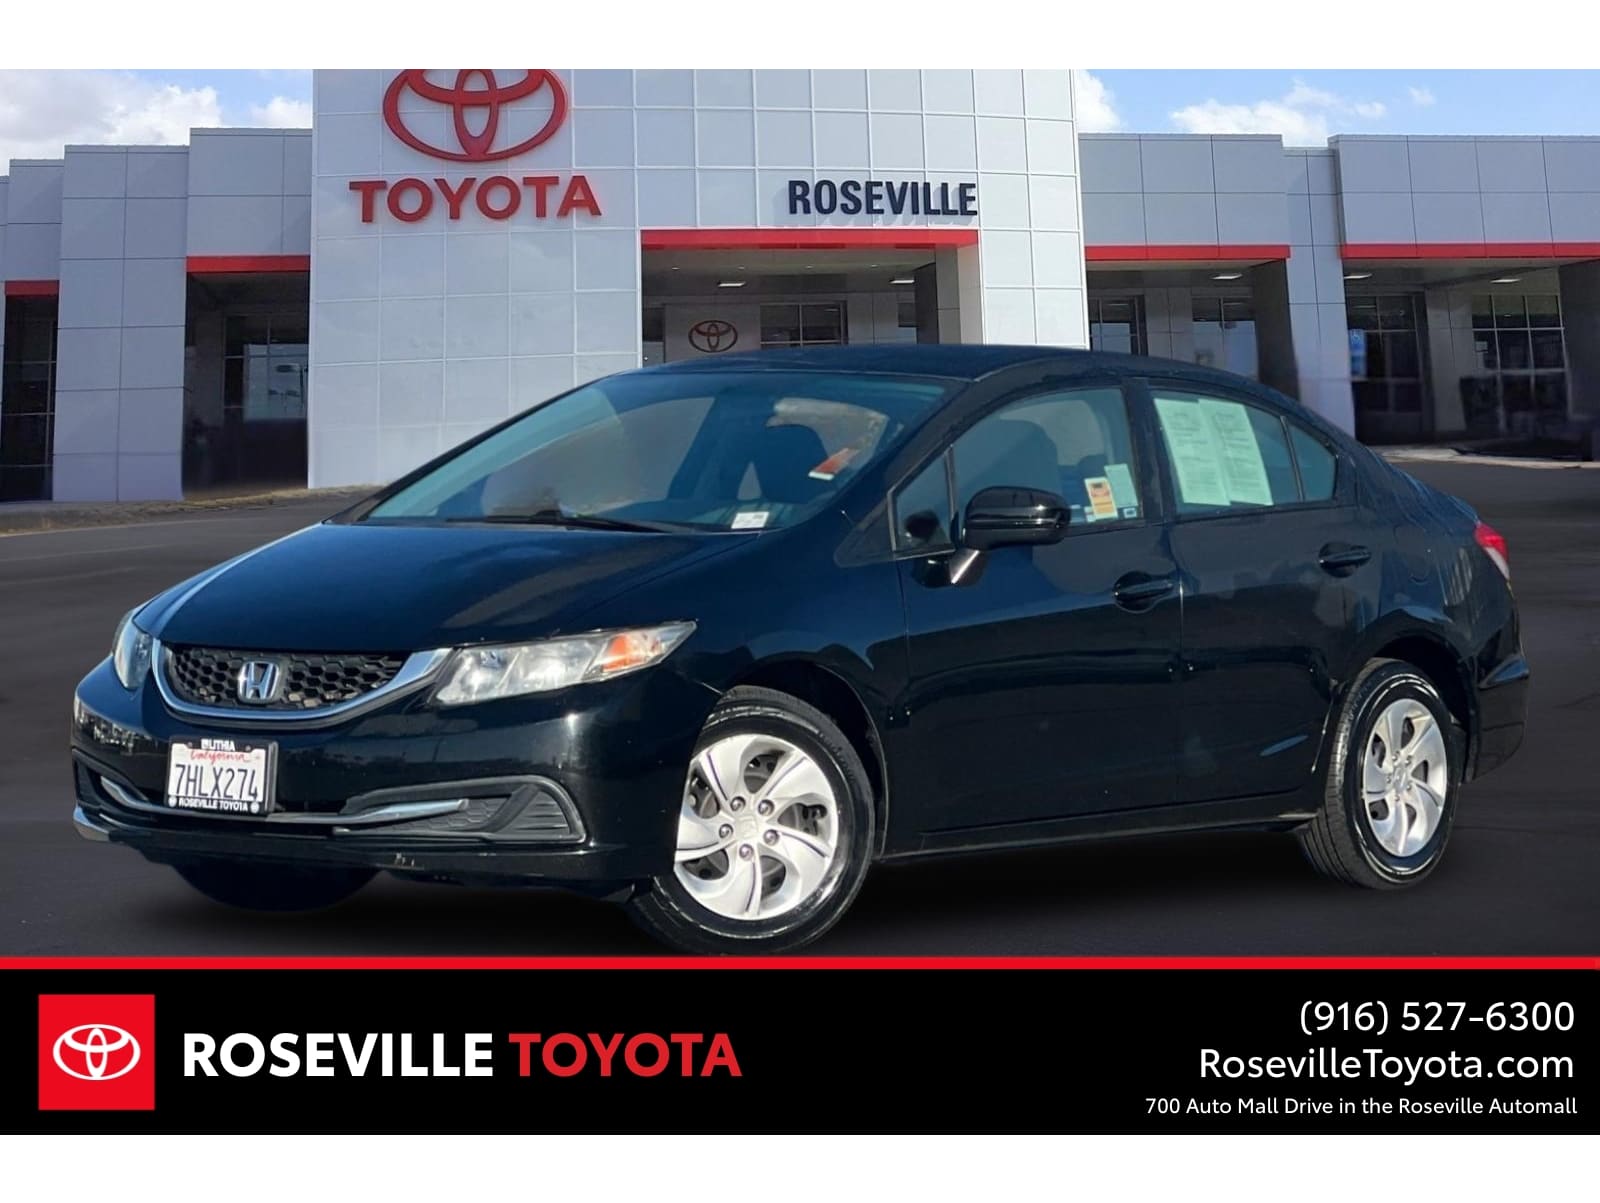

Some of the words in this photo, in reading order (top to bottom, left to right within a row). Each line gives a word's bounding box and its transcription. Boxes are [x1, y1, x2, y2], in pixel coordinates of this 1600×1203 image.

[349, 175, 602, 223] TOYOTA
[788, 180, 979, 217] ROSEVILLE
[190, 750, 250, 764] California
[175, 763, 258, 800] 7HLX274
[178, 797, 218, 810] ROSEVILLE
[219, 801, 248, 812] TOYOTA
